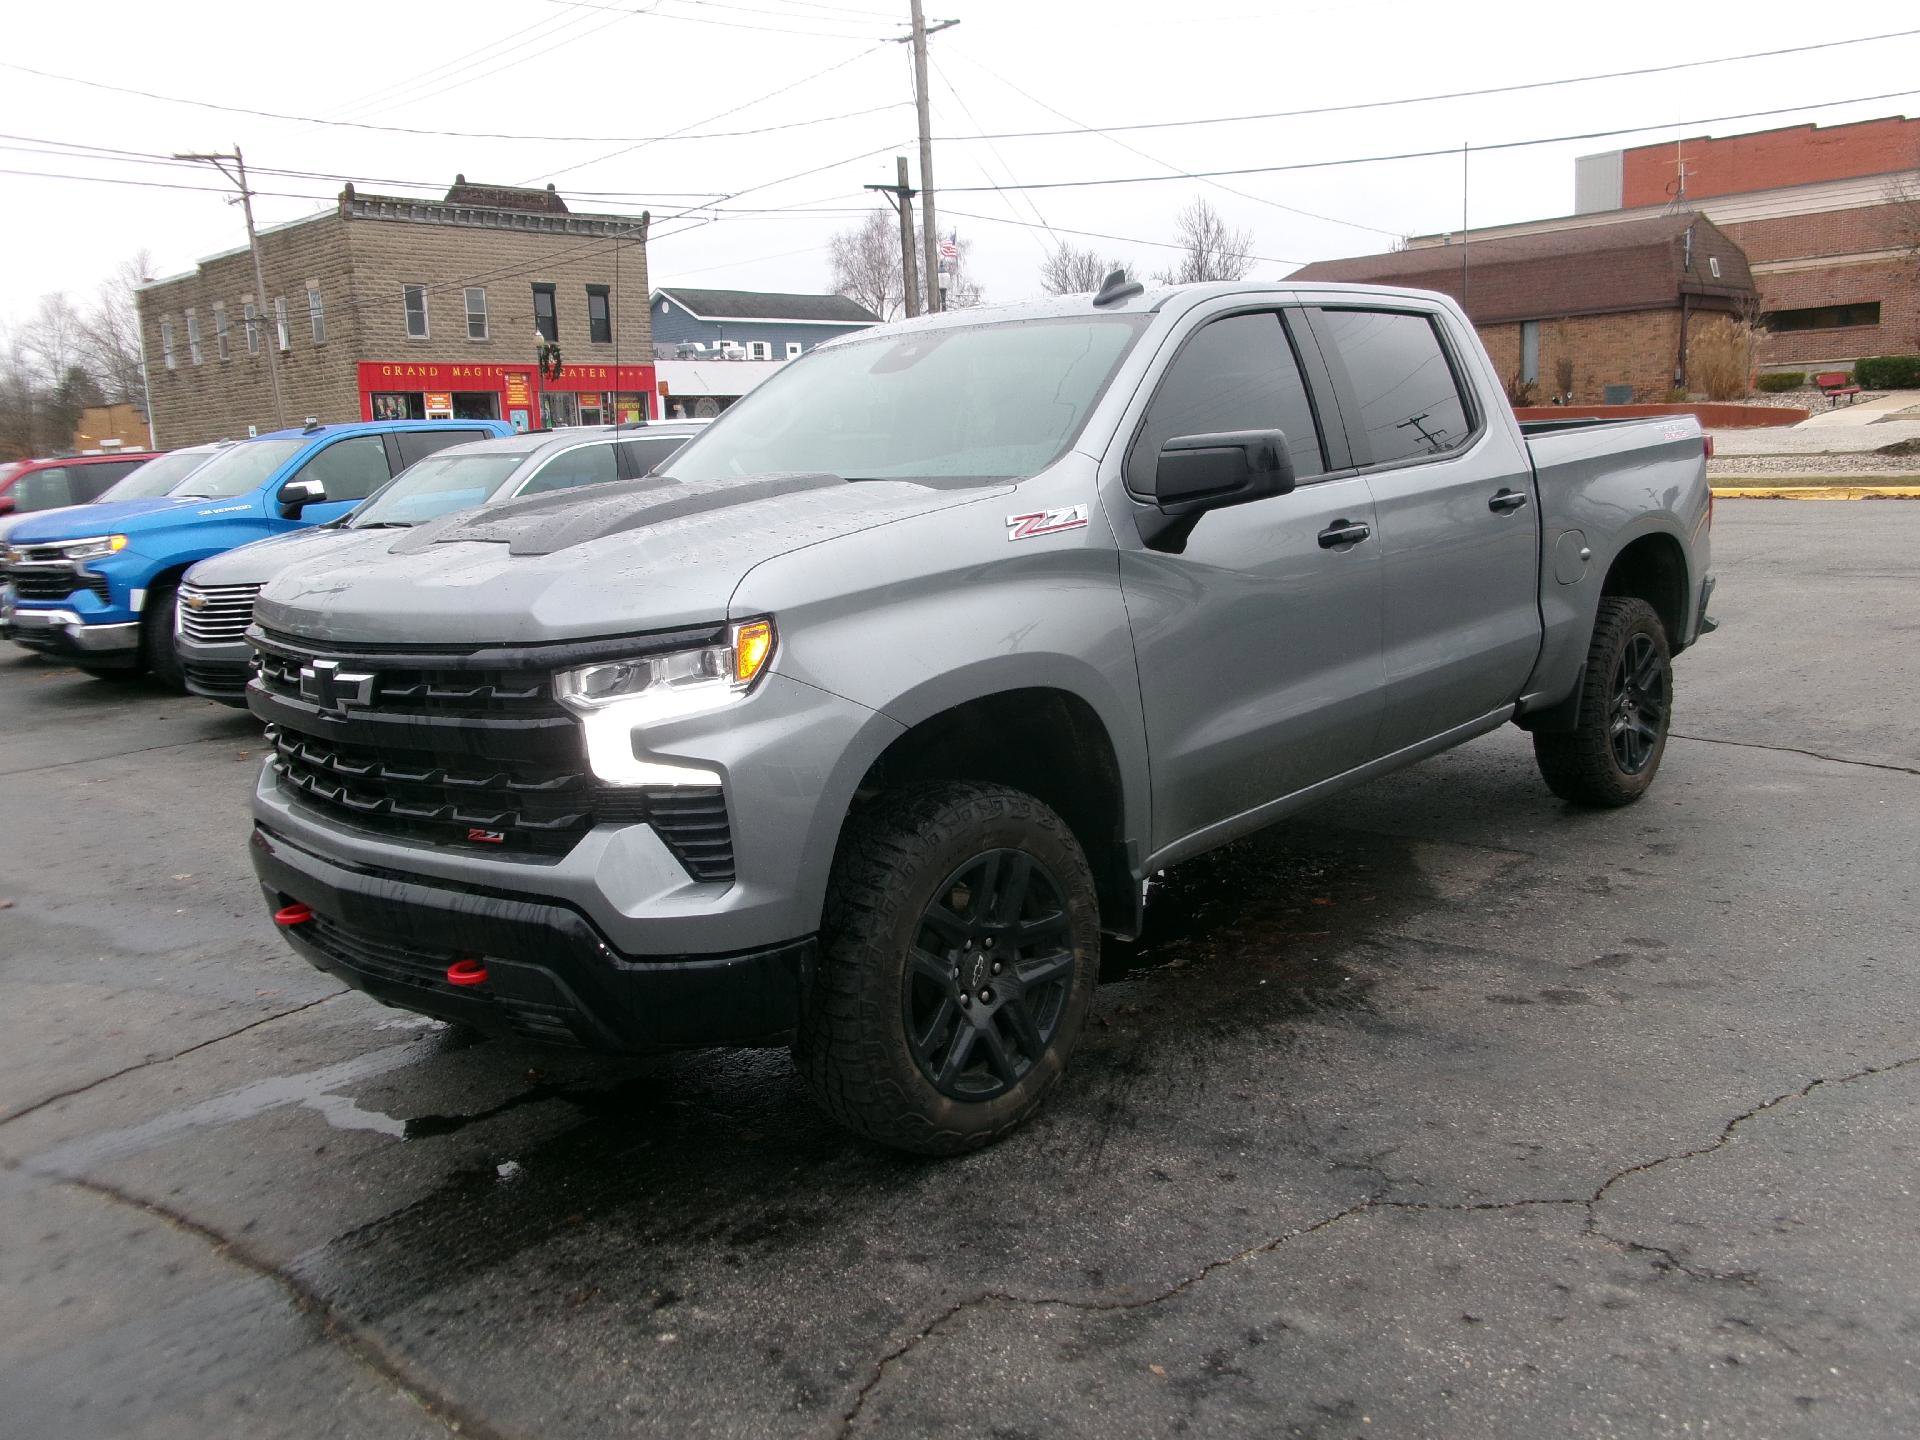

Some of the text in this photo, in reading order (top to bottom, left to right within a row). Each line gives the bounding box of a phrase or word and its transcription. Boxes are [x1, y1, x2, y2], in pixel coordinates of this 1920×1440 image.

[382, 365, 608, 378] GRAND MAGIC EATER
[1006, 503, 1088, 541] Z71
[467, 828, 505, 843] Z71
